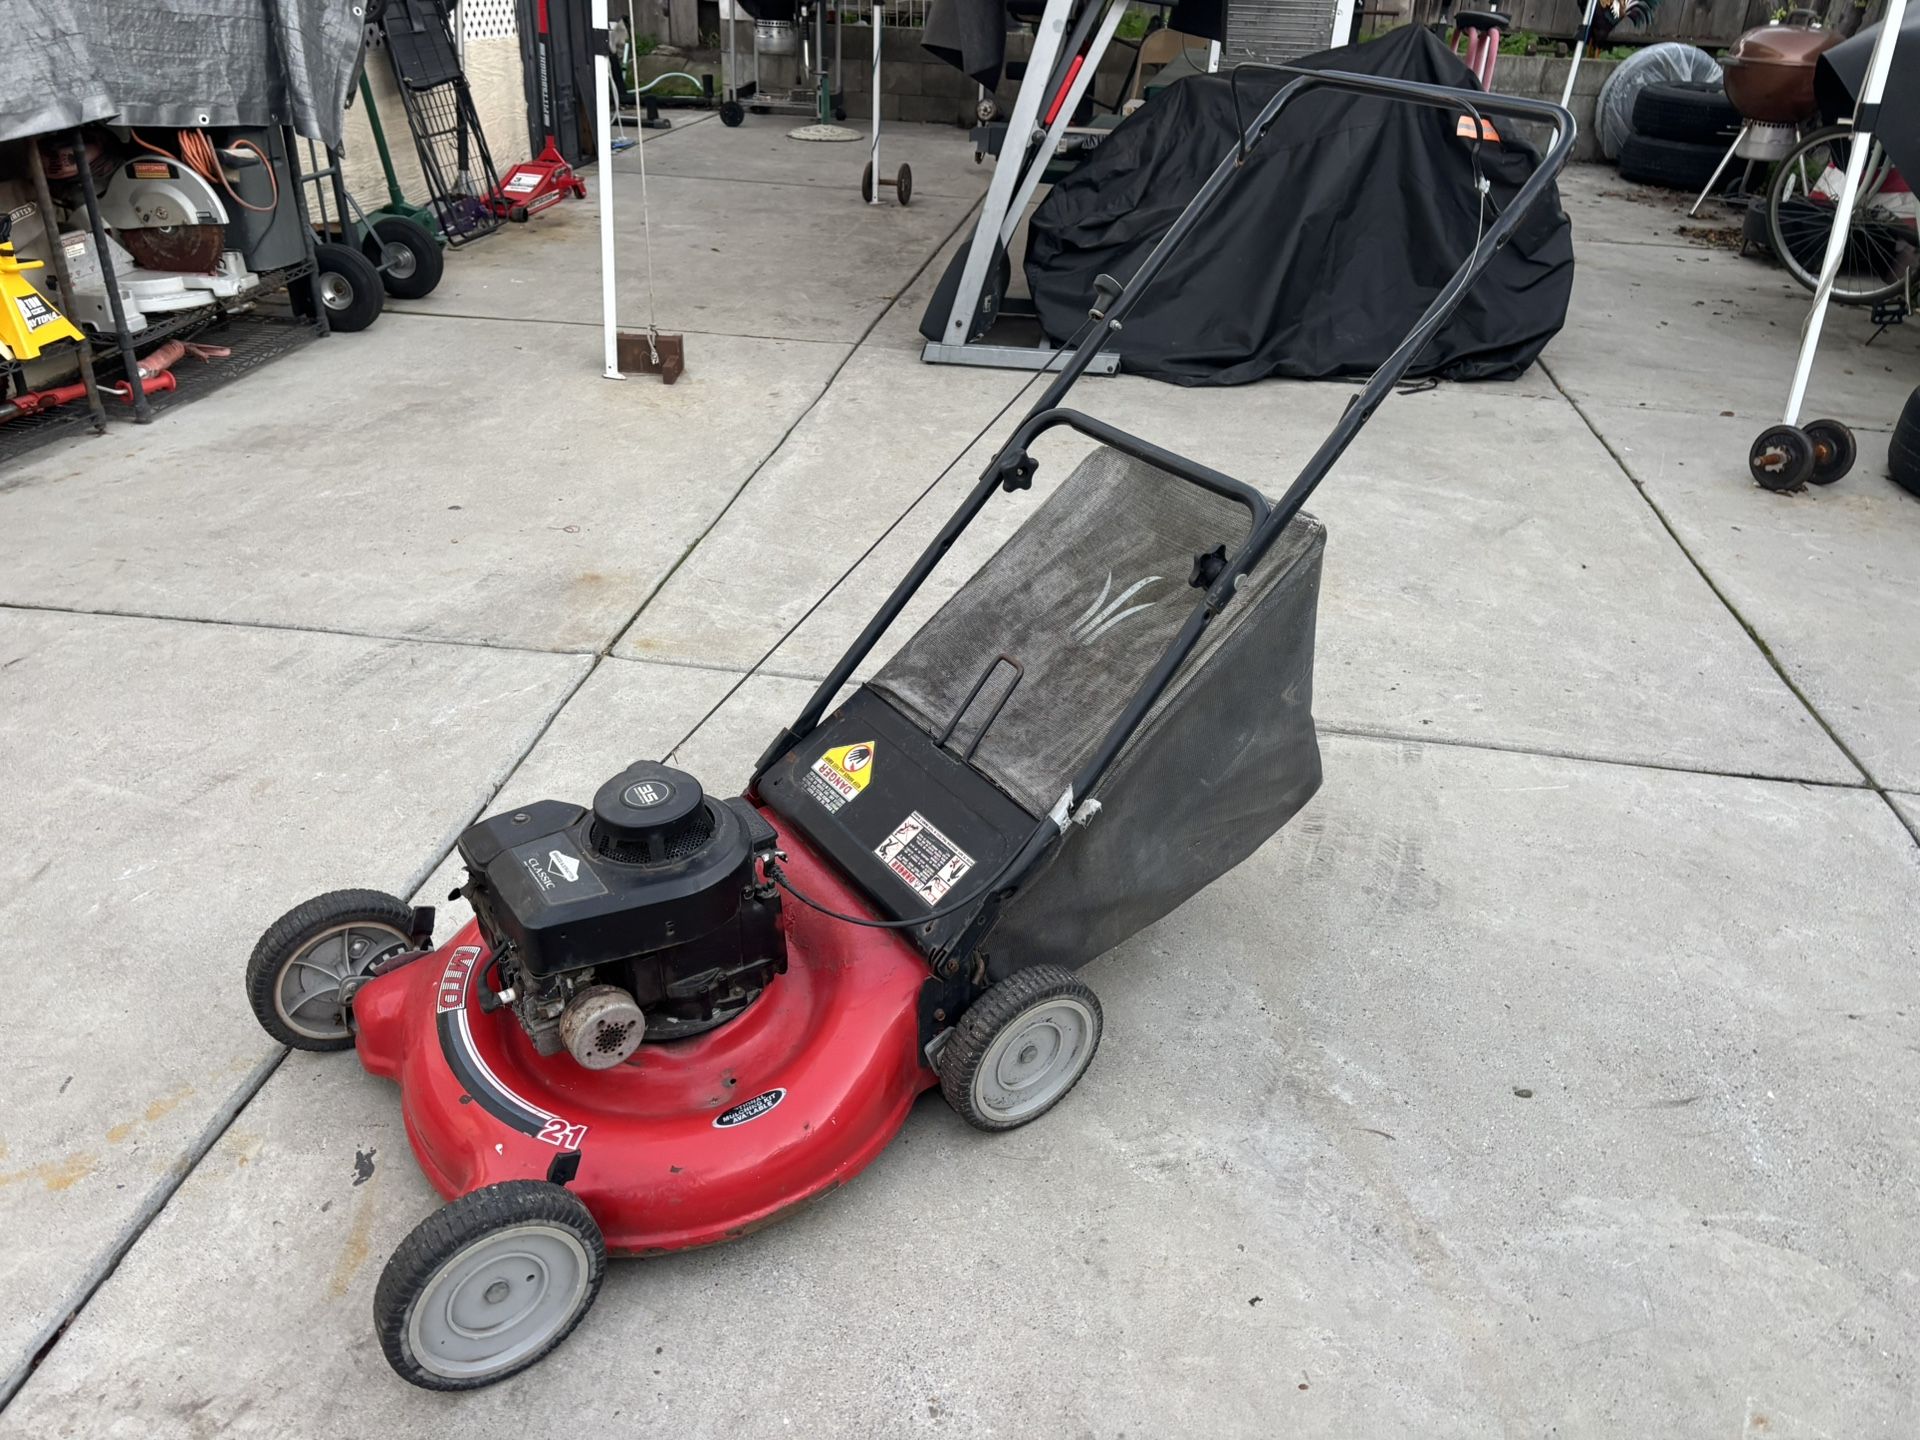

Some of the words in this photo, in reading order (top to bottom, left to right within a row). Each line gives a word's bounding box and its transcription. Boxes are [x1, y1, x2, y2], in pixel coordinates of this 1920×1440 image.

[819, 763, 852, 795] DANGER
[528, 858, 556, 889] CLASSIC
[891, 861, 916, 883] DANGER
[722, 1101, 763, 1123] MULCHING
[764, 1092, 776, 1103] KIT
[537, 1118, 588, 1150] 21
